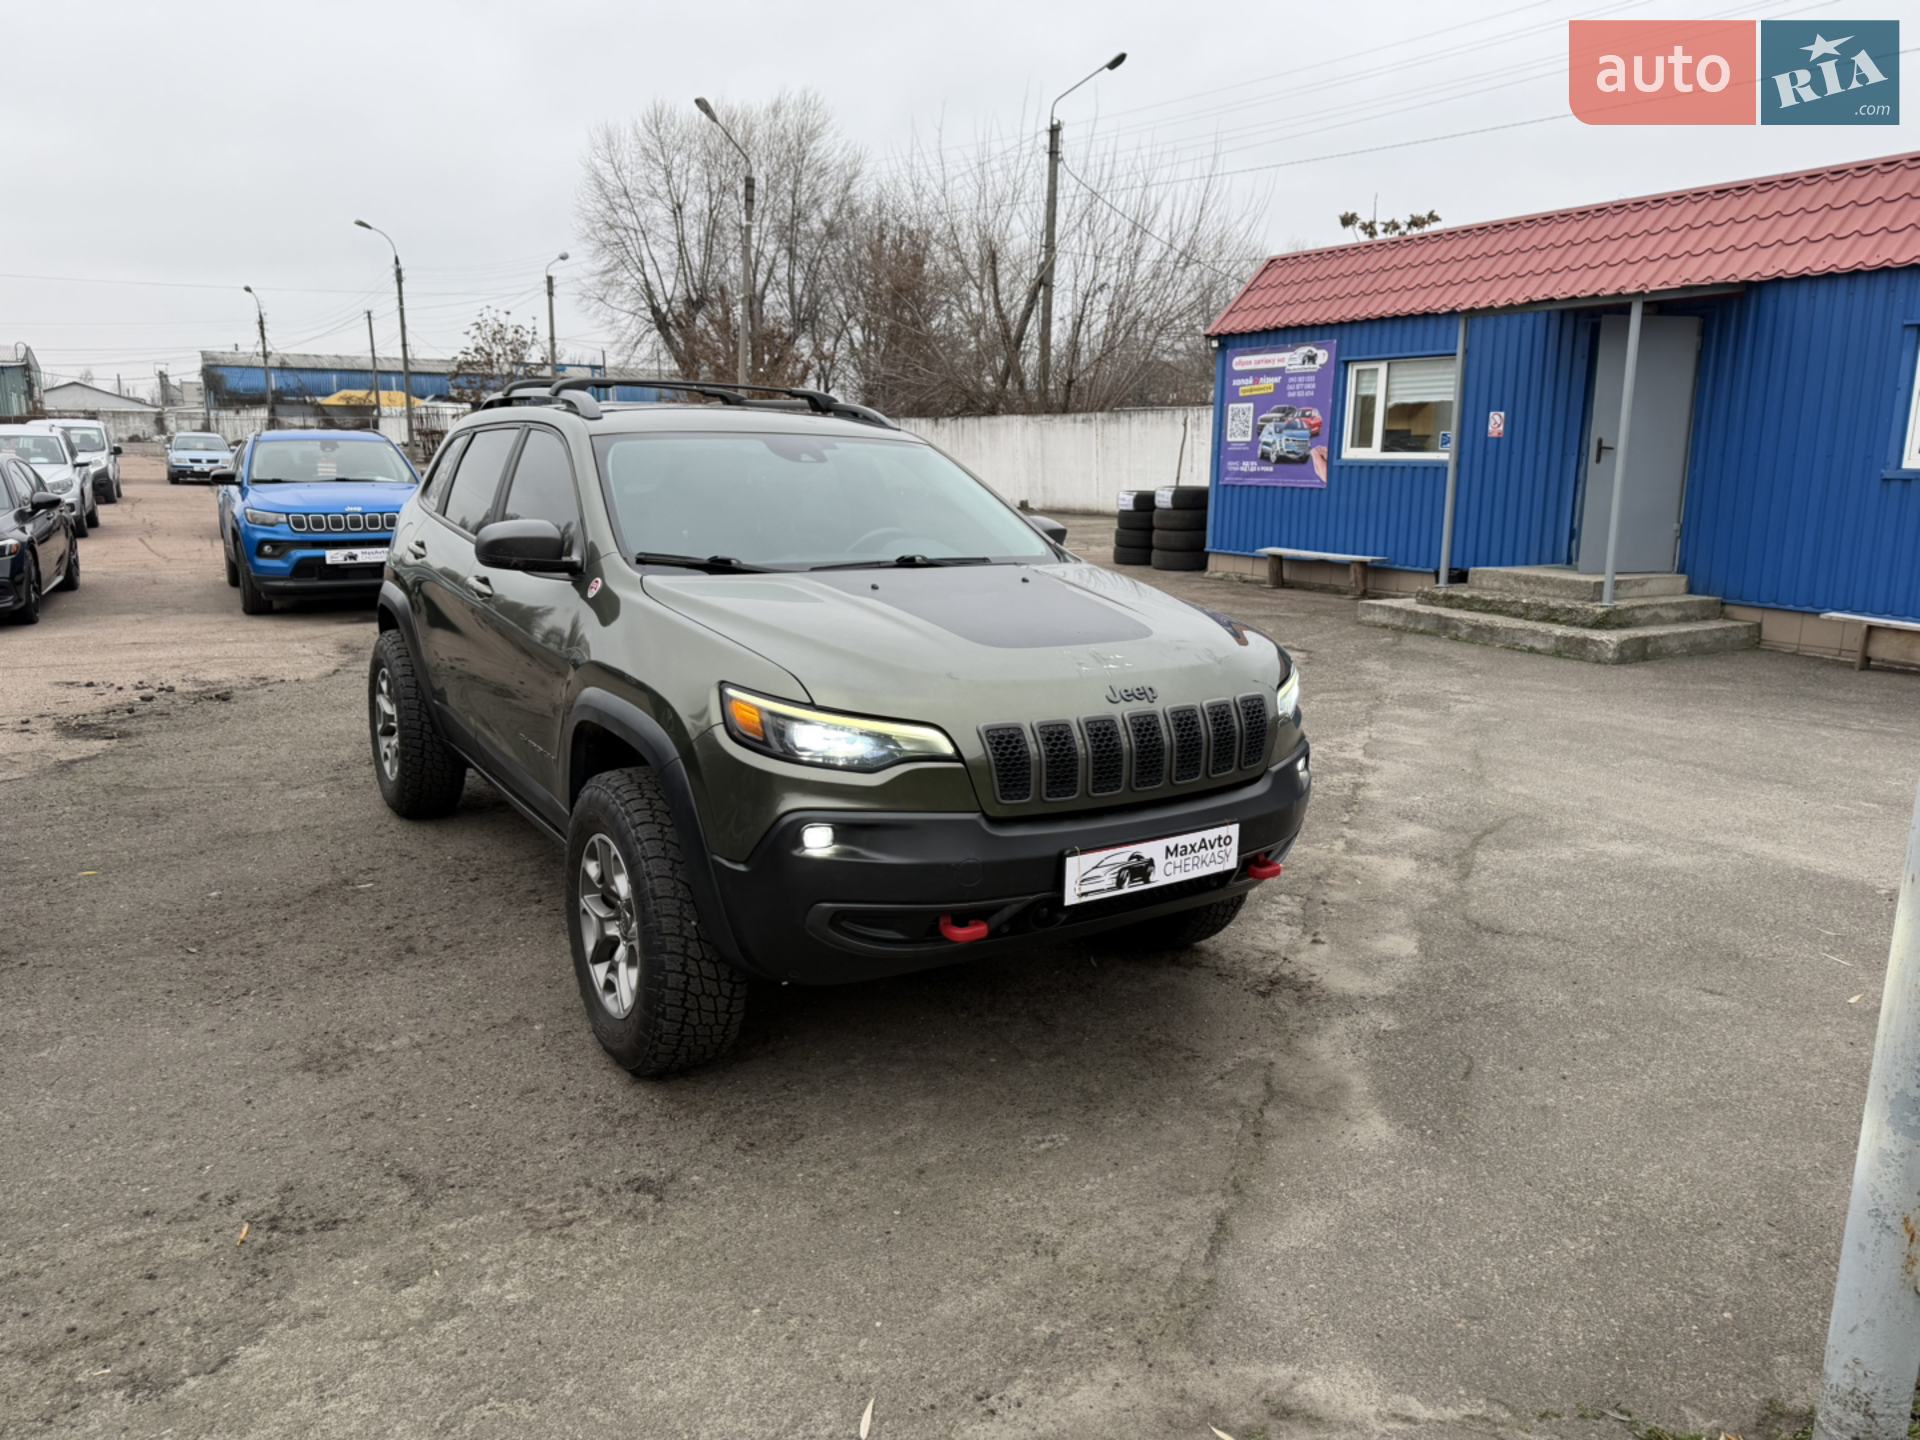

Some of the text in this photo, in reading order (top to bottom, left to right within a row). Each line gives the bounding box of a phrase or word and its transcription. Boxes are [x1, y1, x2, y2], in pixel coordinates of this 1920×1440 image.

[1105, 684, 1158, 704] Jeep
[1164, 833, 1233, 860] MaxAvto
[1163, 847, 1233, 877] CHERKASY
